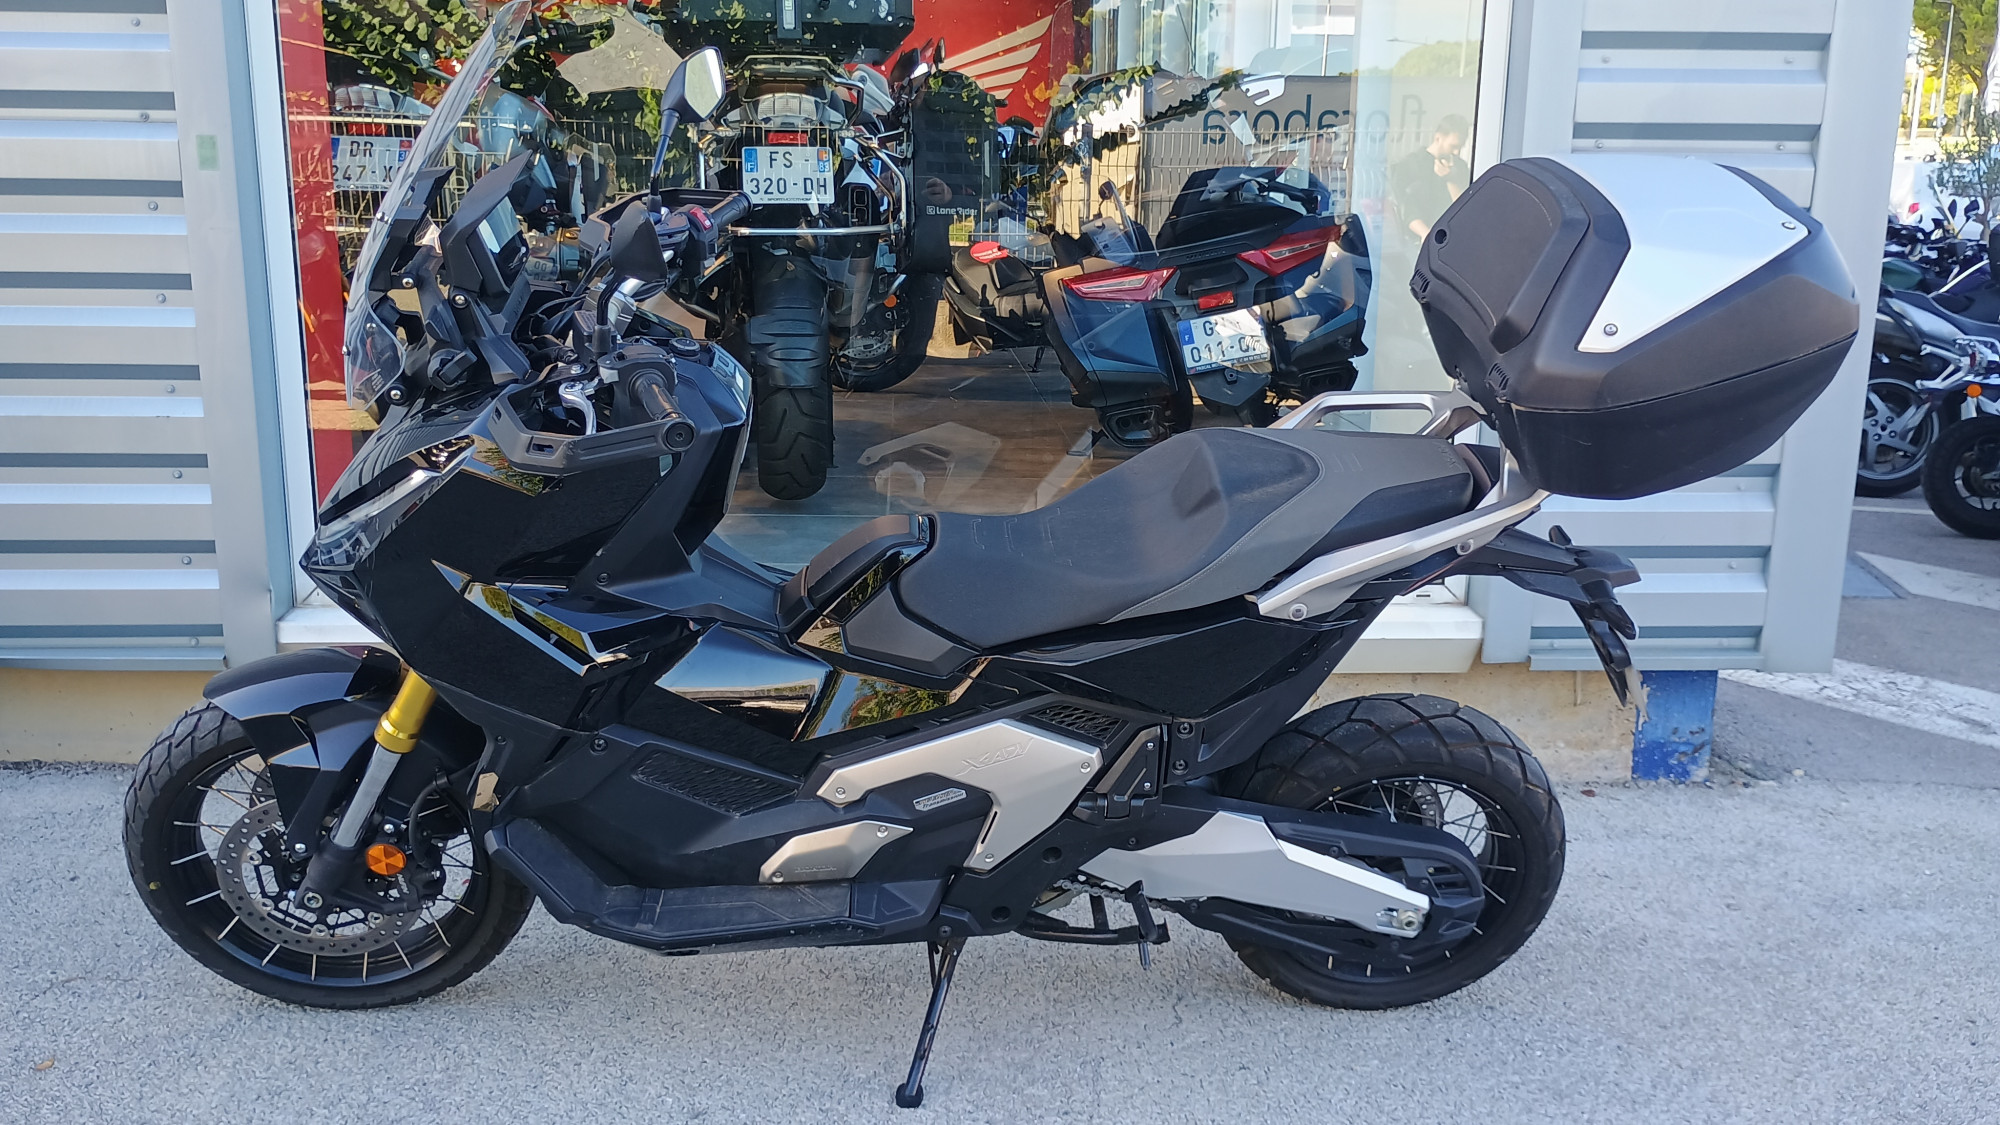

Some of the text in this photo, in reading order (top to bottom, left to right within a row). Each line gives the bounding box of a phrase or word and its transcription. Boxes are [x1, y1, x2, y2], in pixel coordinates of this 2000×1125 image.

[349, 140, 374, 158] DR
[769, 151, 793, 169] FS
[332, 164, 402, 183] 247-X
[749, 177, 828, 196] 320-DH
